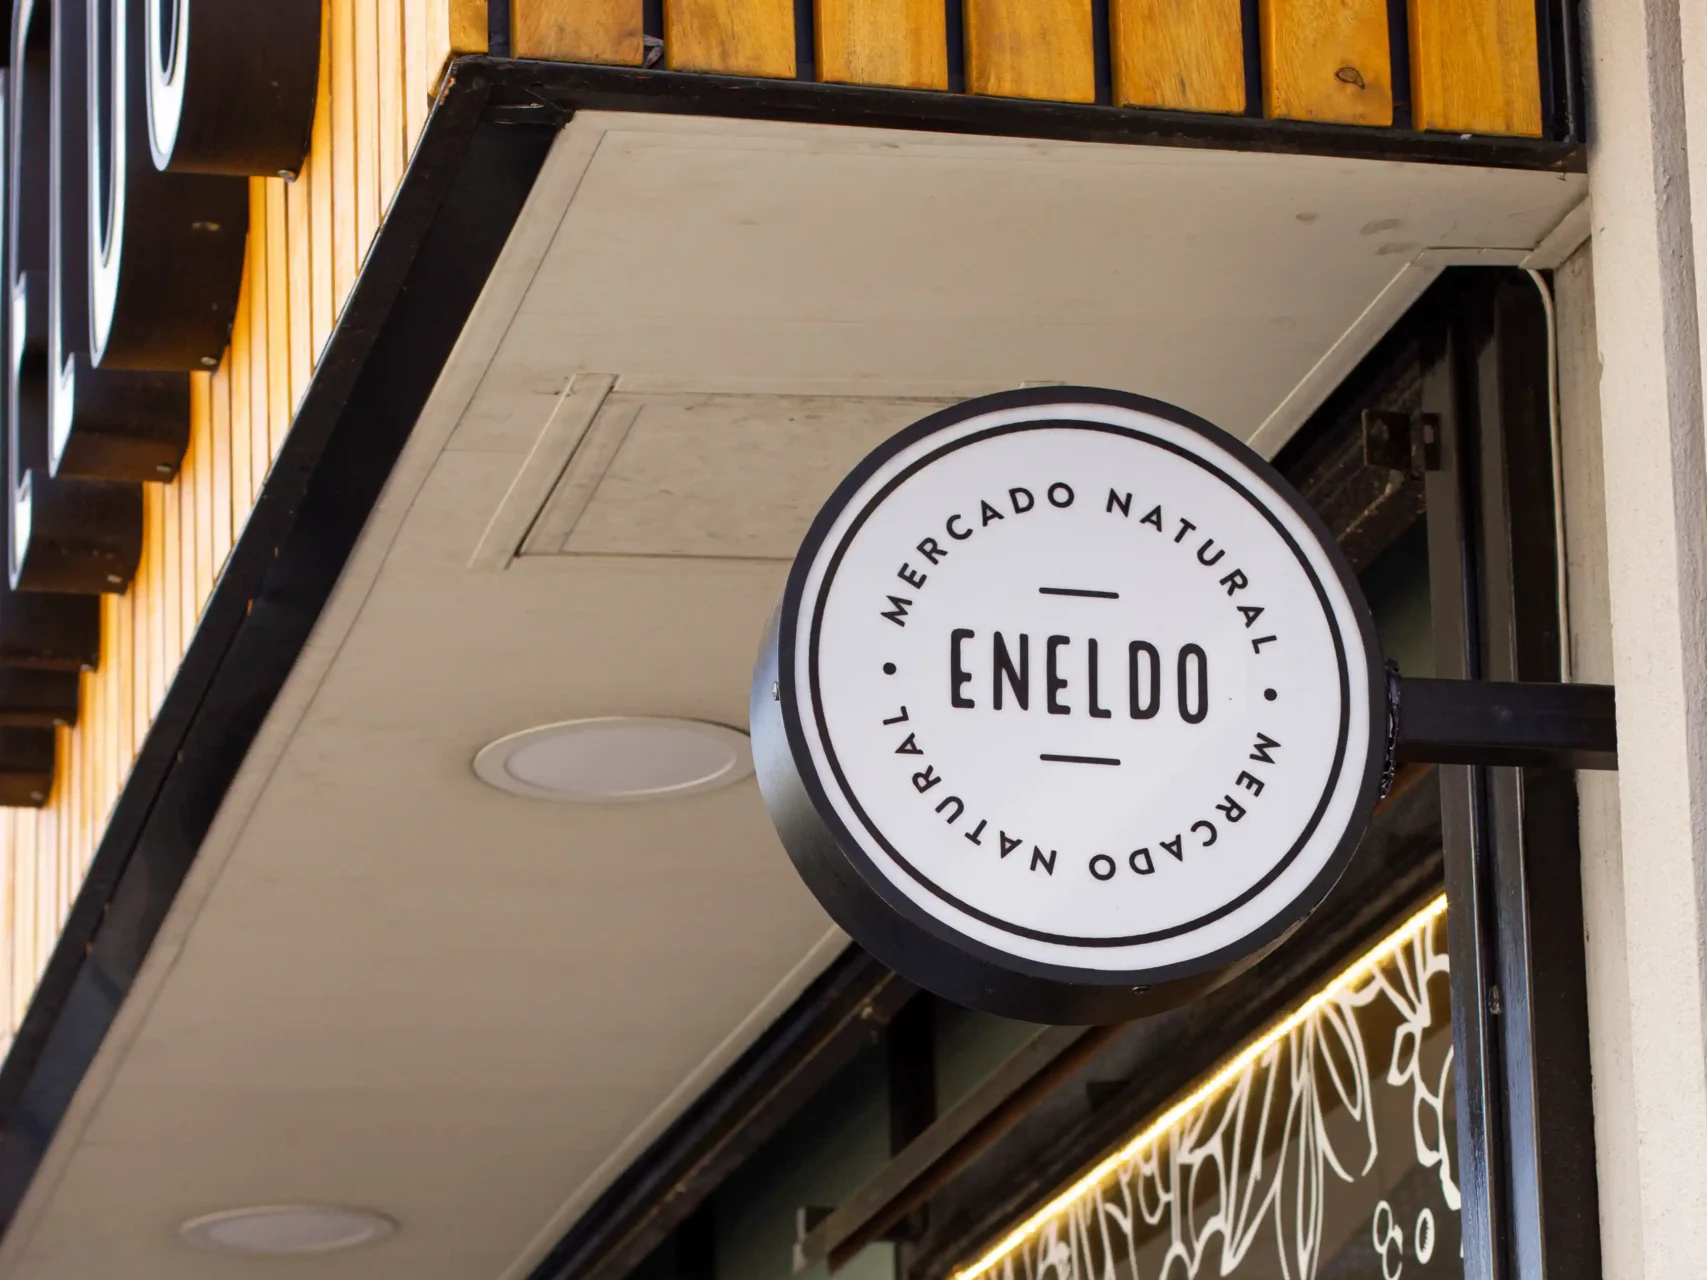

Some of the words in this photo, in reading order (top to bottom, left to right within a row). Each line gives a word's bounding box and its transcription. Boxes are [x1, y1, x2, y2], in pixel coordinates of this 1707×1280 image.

[880, 481, 1075, 628] MERCADO
[1105, 487, 1278, 655] NATURAL
[950, 628, 1209, 725] ENELDO
[882, 705, 1057, 876] NATURAL
[1088, 731, 1282, 881] MERCADO
